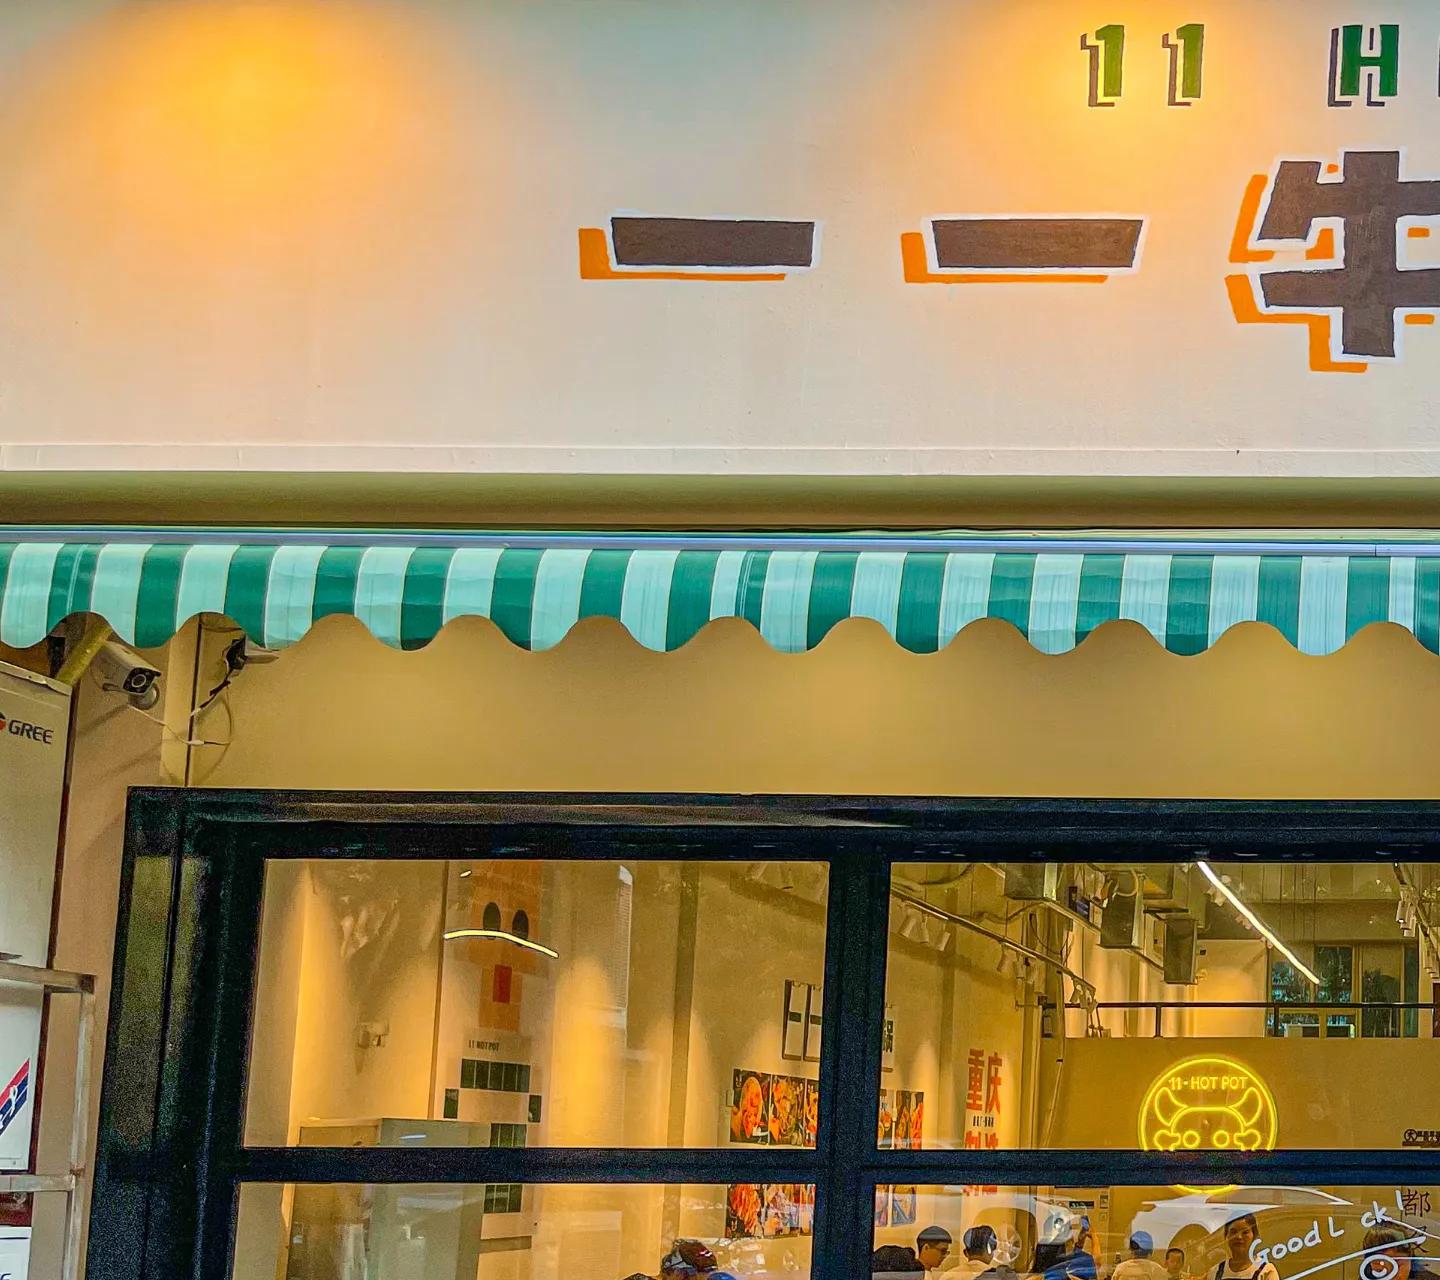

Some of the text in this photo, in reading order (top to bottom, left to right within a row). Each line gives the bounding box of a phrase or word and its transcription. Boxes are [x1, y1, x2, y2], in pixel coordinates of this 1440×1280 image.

[1081, 23, 1206, 107] 11
[9, 720, 54, 745] GREE
[967, 1048, 1003, 1114] 重庆
[1221, 1076, 1249, 1091] POT
[1248, 1220, 1322, 1268] Good
